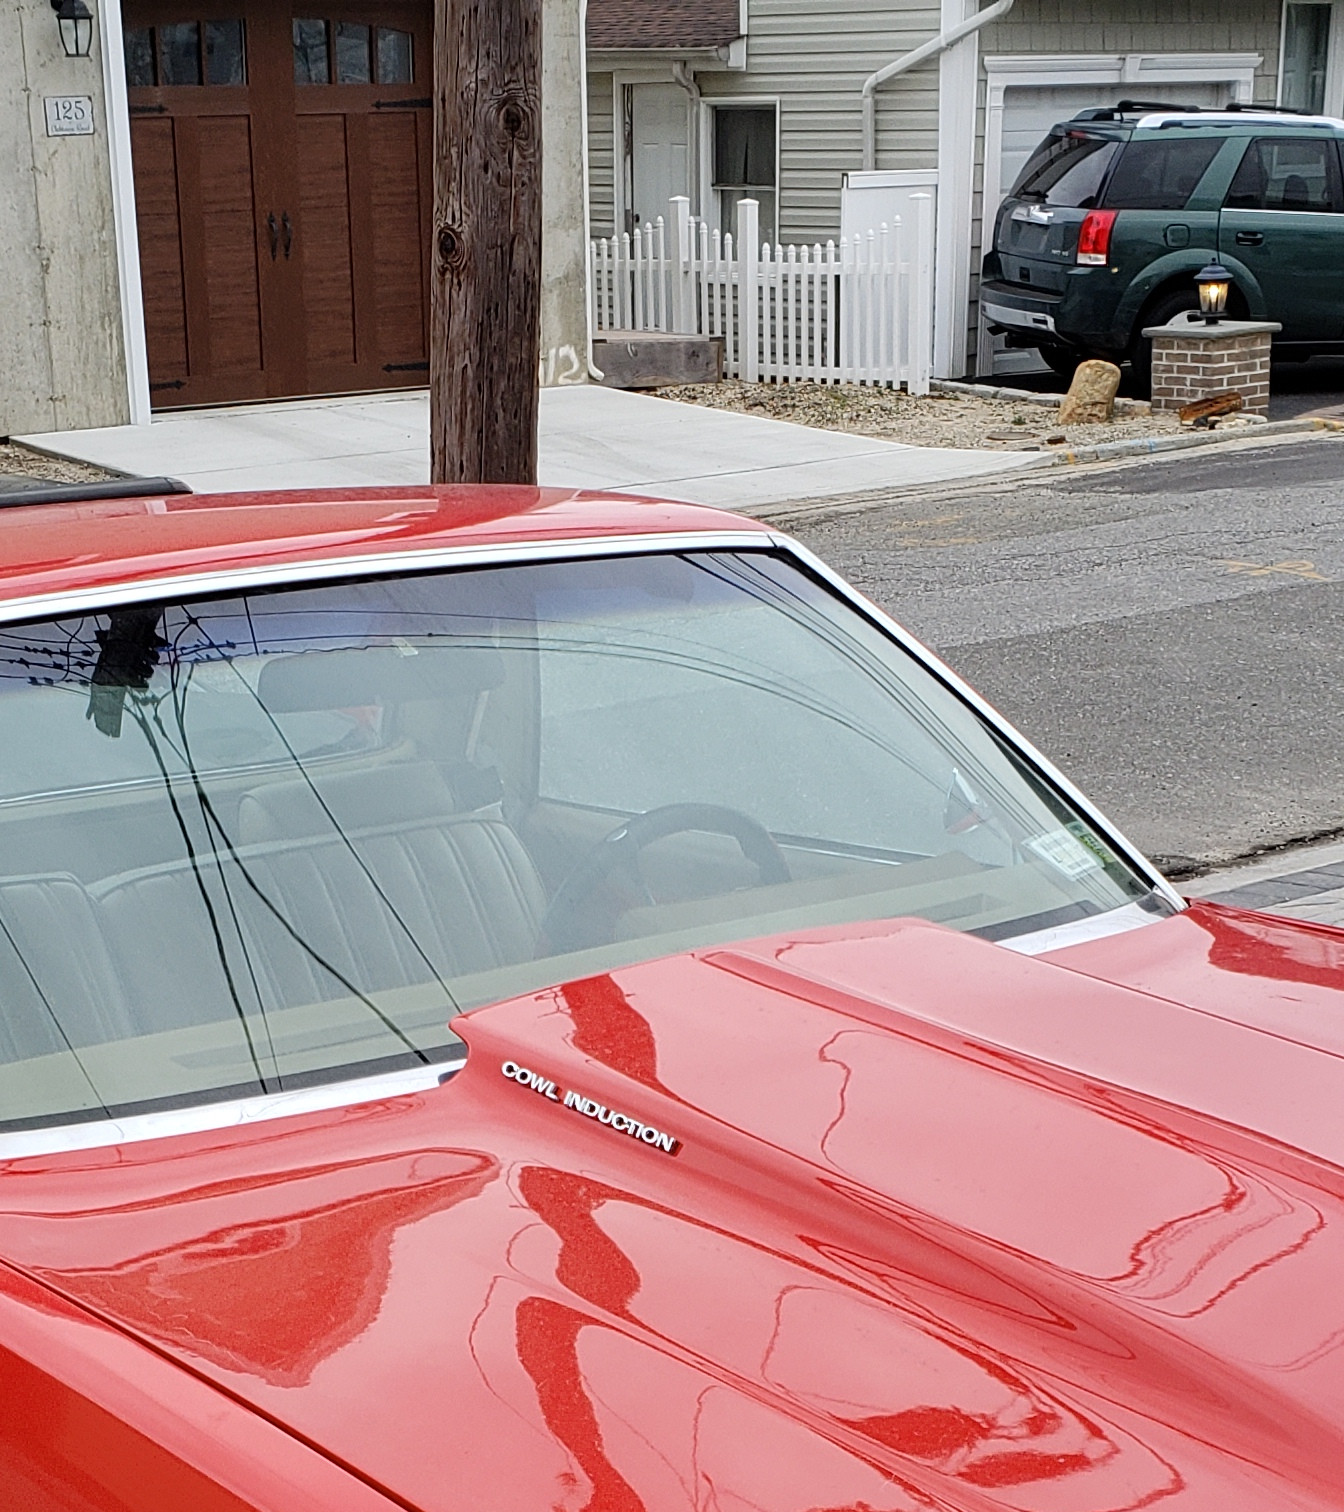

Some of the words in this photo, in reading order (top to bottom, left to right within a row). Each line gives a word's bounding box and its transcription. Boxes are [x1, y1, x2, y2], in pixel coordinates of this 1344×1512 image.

[54, 100, 85, 121] 125
[501, 1061, 560, 1102] COWL
[563, 1090, 679, 1155] INDUCTION
